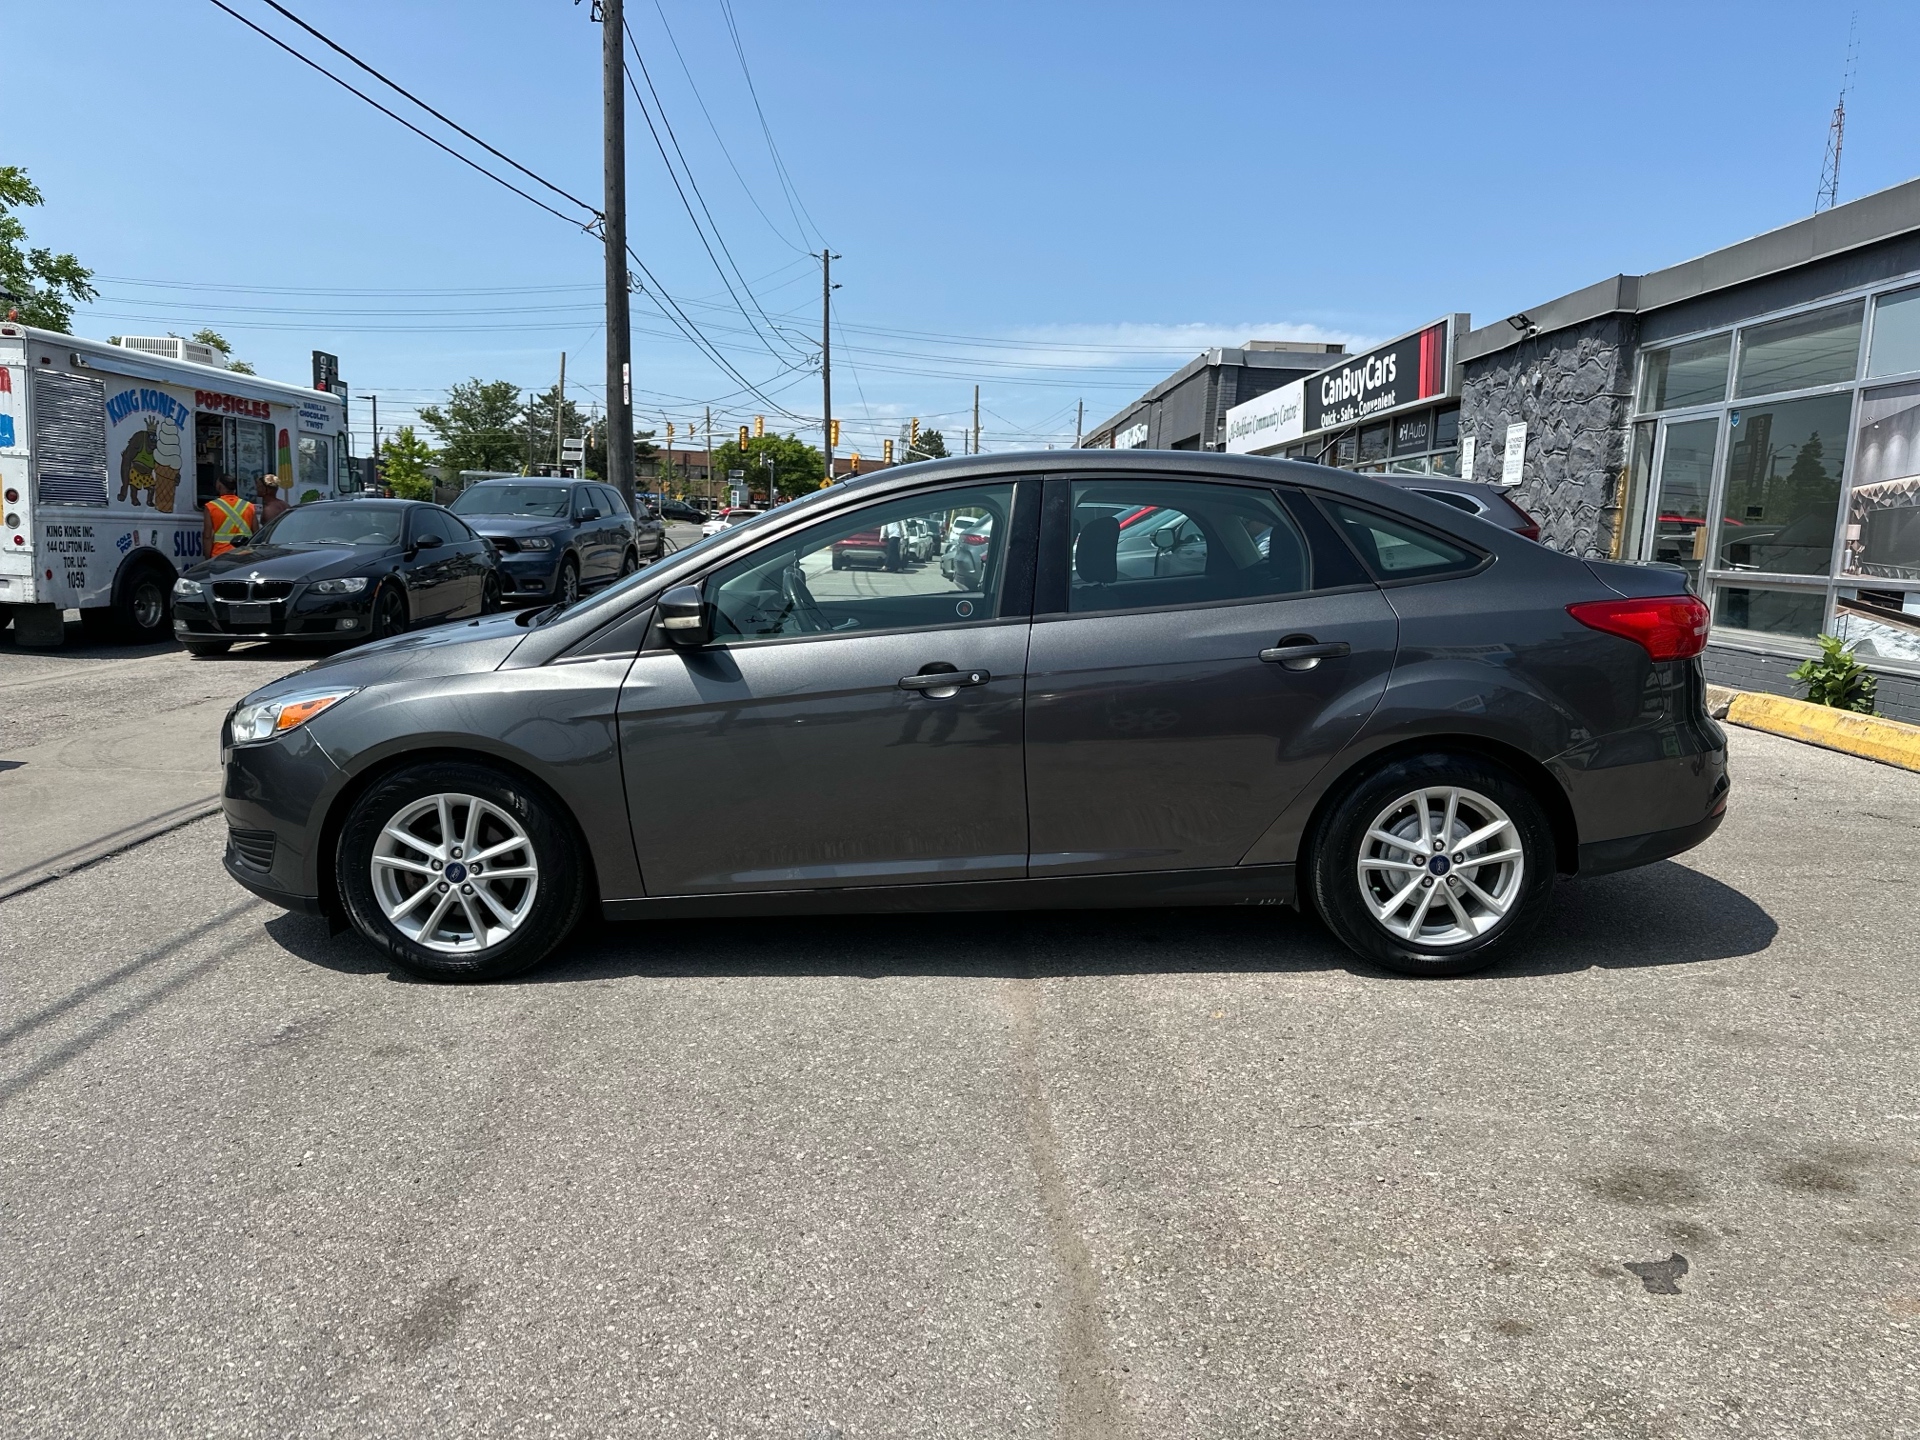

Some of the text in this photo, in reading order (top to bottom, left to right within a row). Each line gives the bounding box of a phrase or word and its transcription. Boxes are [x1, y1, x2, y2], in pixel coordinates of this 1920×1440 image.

[1321, 353, 1397, 406] CanBuyCars
[106, 388, 190, 431] KING KONE II
[194, 390, 271, 420] POPSICLES
[303, 402, 326, 412] VANILLA
[1321, 409, 1337, 428] Quick
[1340, 404, 1354, 422] Safe
[1359, 389, 1396, 416] Convenient
[299, 409, 329, 421] CHOCOLATE
[1253, 407, 1279, 434] Community
[1280, 404, 1297, 426] Centre
[305, 420, 324, 429] TWIST
[1408, 421, 1427, 440] Auto
[46, 525, 95, 538] KING KONE INC.
[46, 541, 58, 553] 144
[58, 541, 82, 553] CLIFTON
[116, 533, 132, 548] COLD
[120, 539, 133, 554] POP
[174, 531, 205, 557] SLUS
[63, 556, 76, 568] TOR.
[67, 571, 85, 589] 1059
